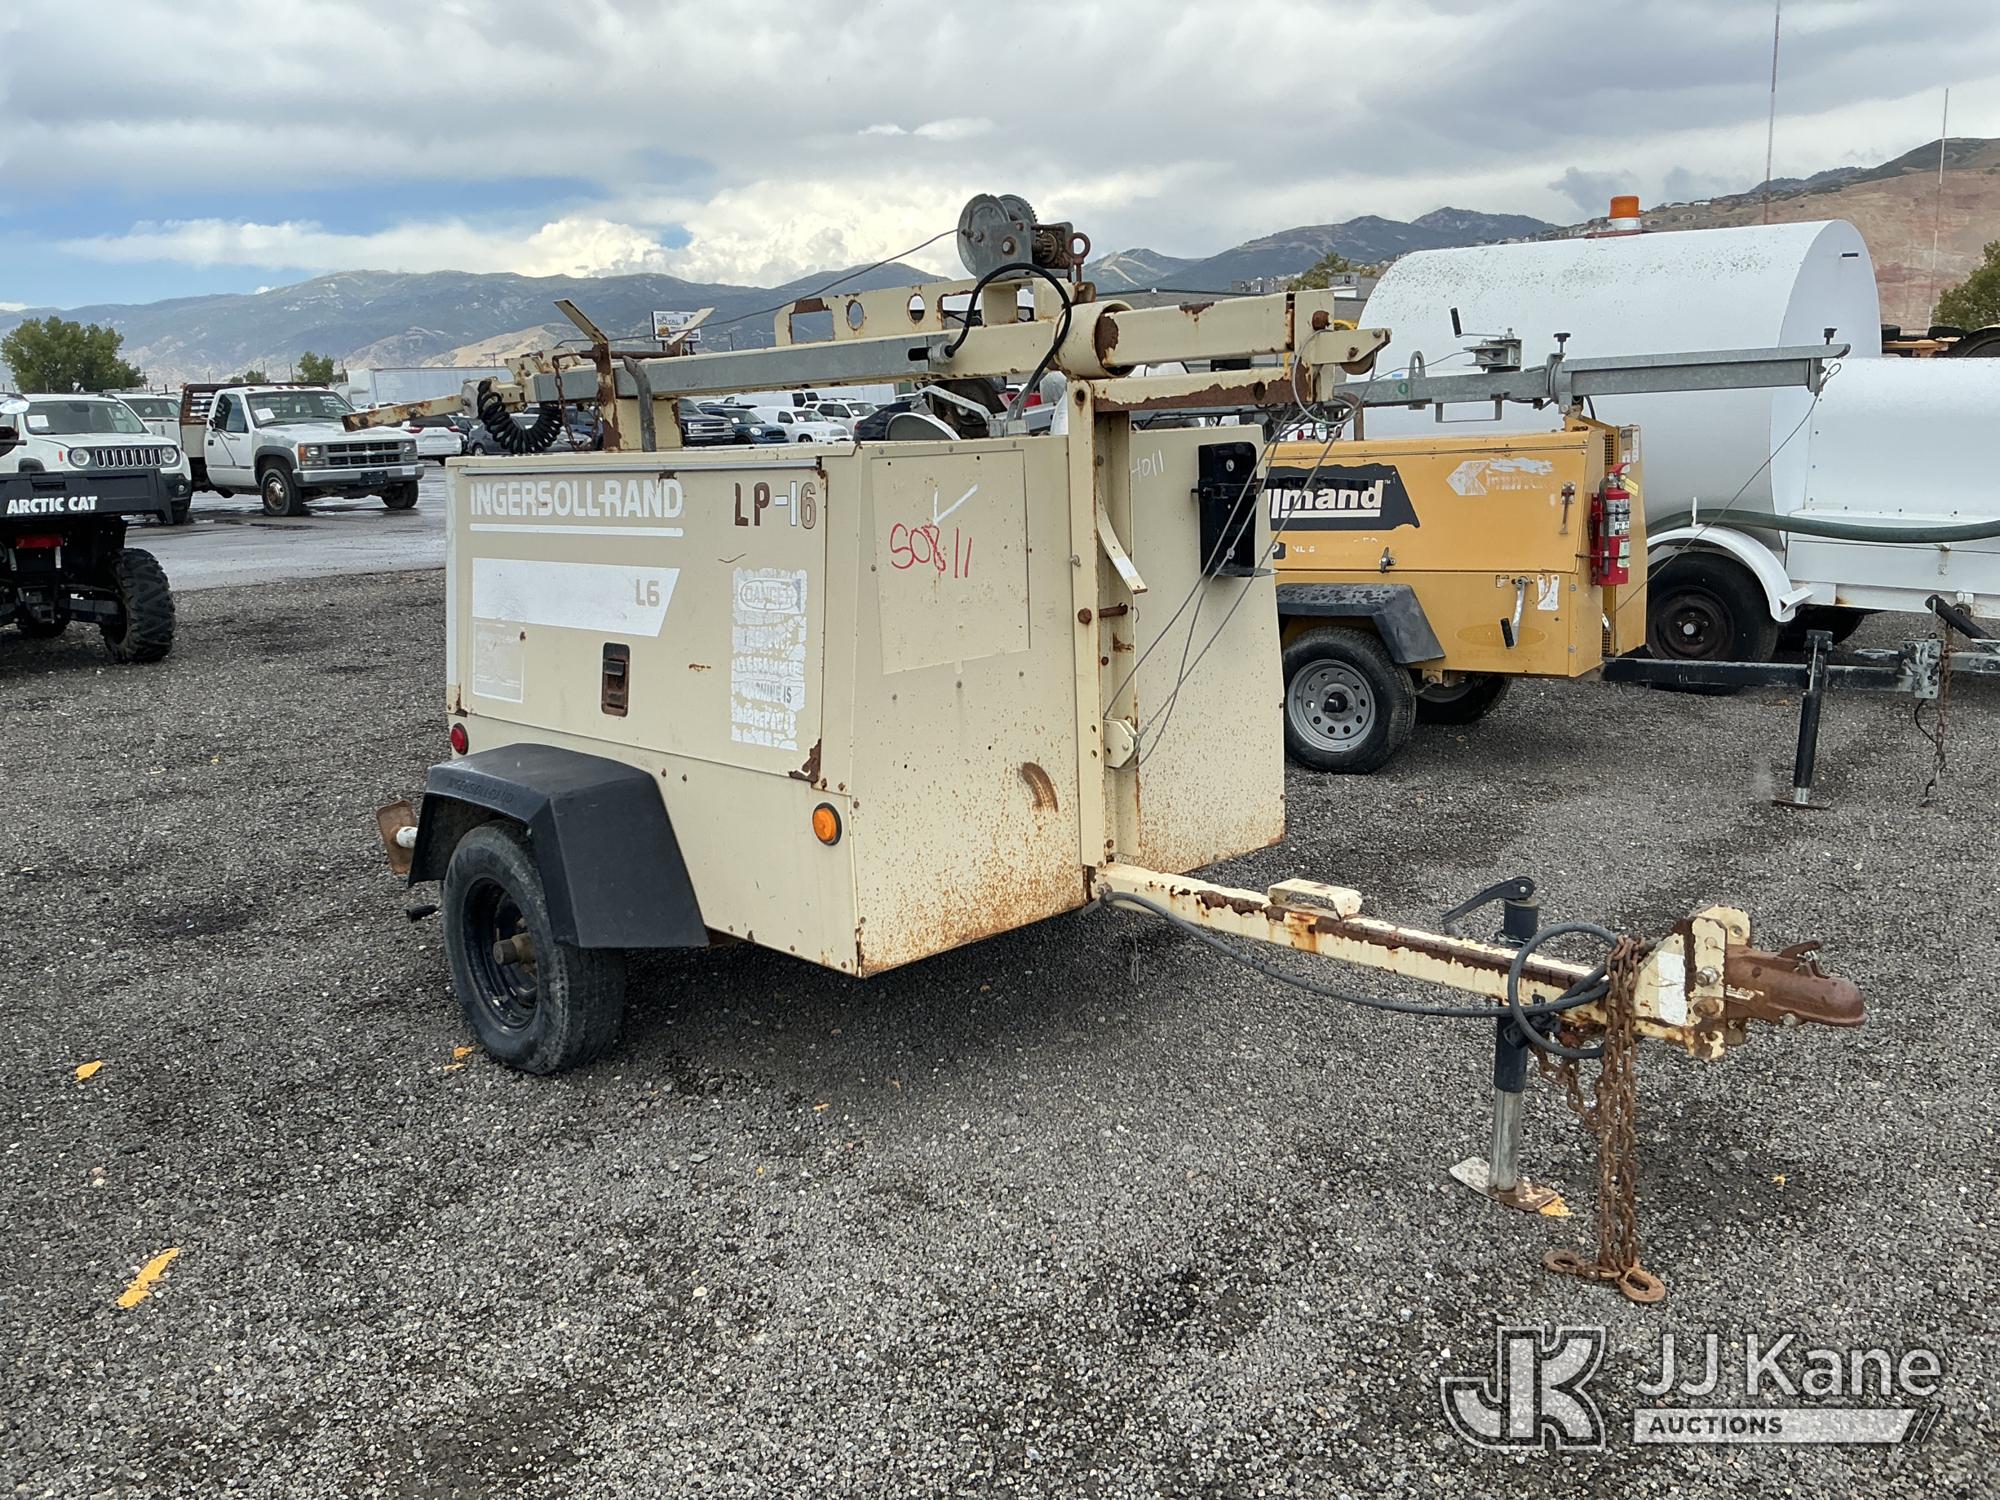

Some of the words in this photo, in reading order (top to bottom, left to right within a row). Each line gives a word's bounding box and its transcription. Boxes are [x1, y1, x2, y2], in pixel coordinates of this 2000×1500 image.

[6, 497, 65, 514] ARCTIC
[68, 495, 98, 511] CAT
[470, 479, 684, 519] INGERSOLL-RAND
[735, 480, 817, 530] LP-16
[635, 578, 661, 608] L6
